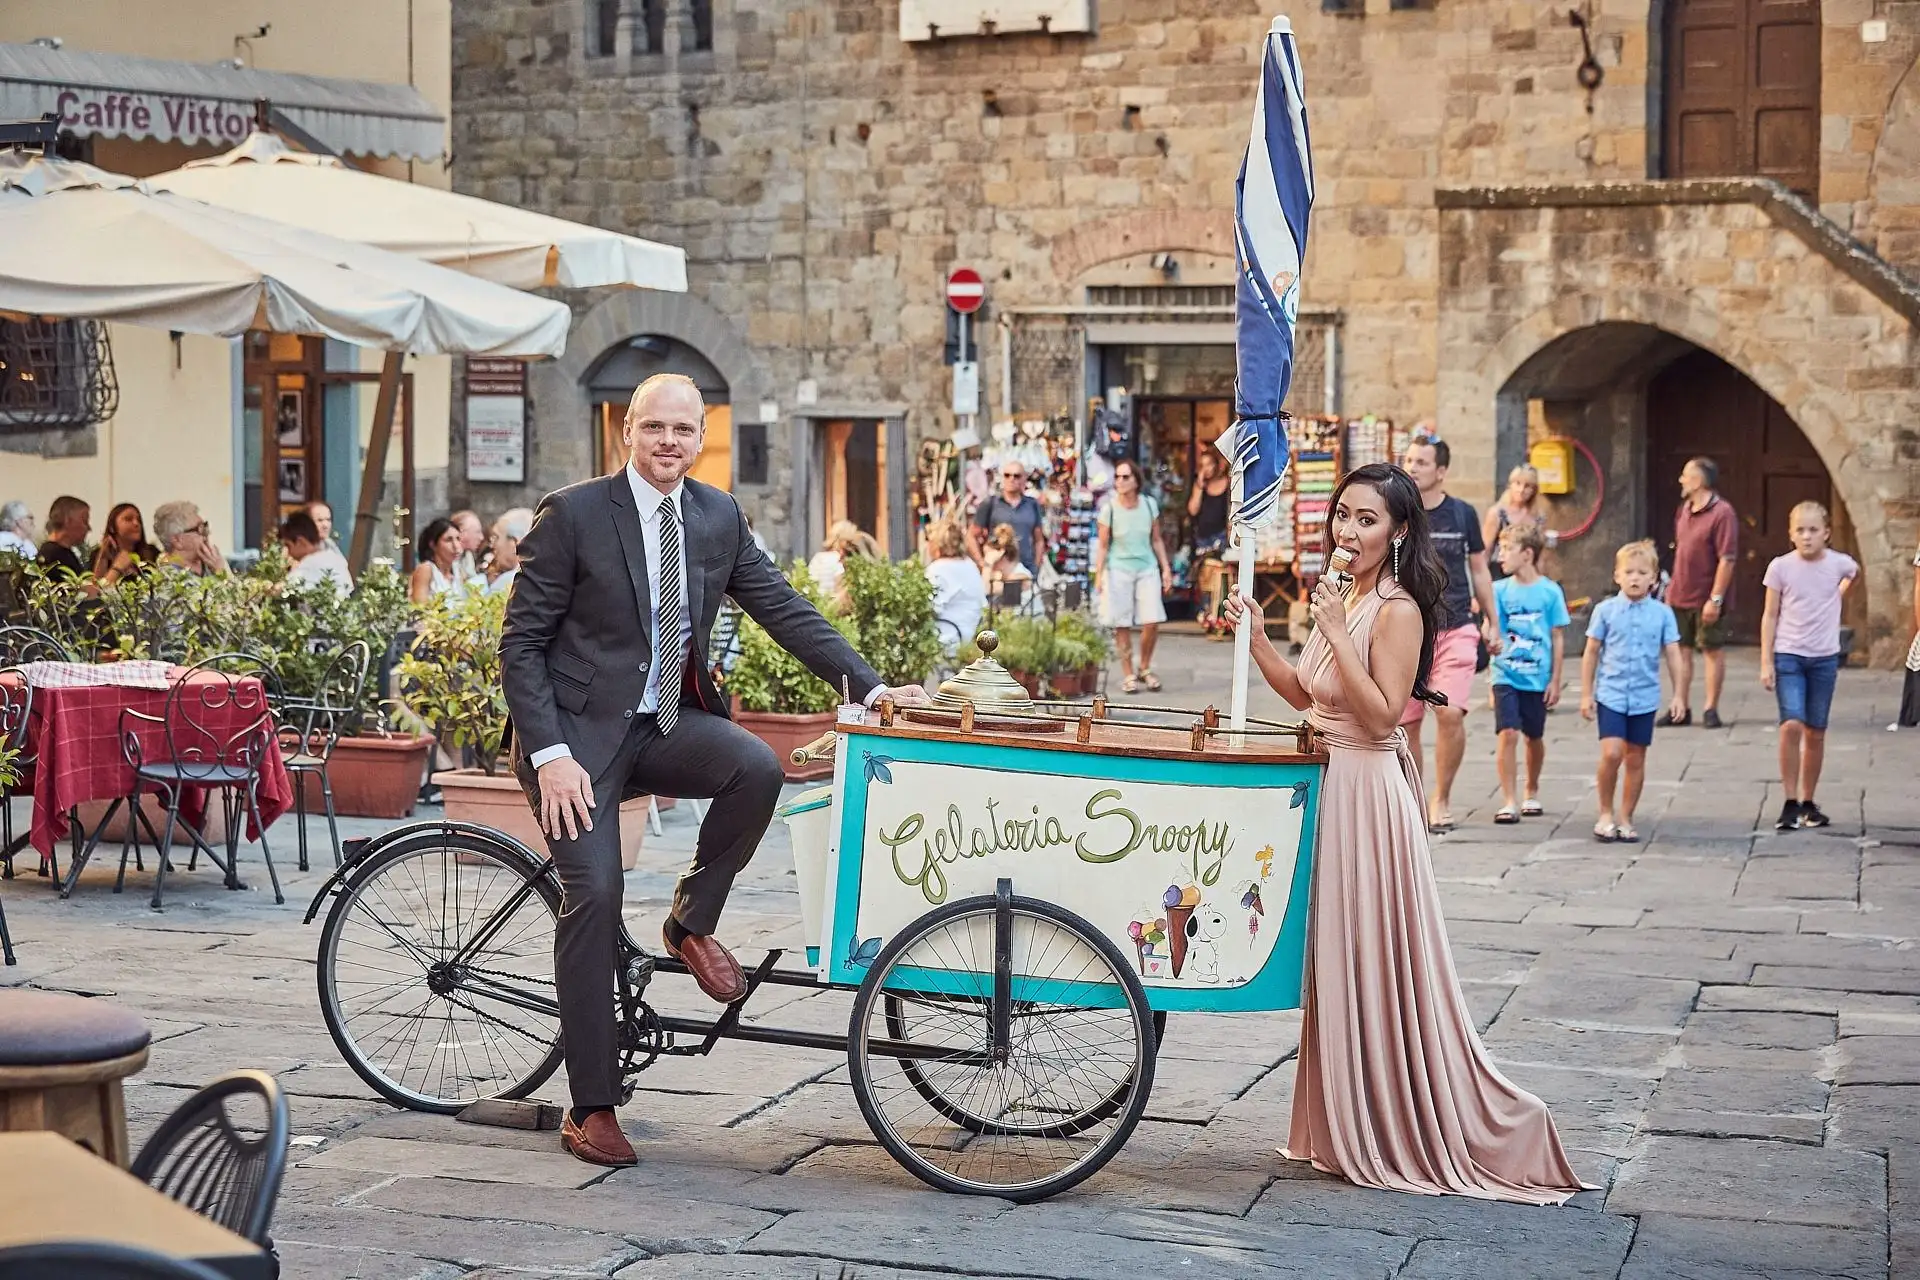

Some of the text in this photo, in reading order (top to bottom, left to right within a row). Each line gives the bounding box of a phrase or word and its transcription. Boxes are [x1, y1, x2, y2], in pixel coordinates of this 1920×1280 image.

[57, 91, 151, 130] Caffè
[879, 788, 1235, 905] Gelateria Snoopy
